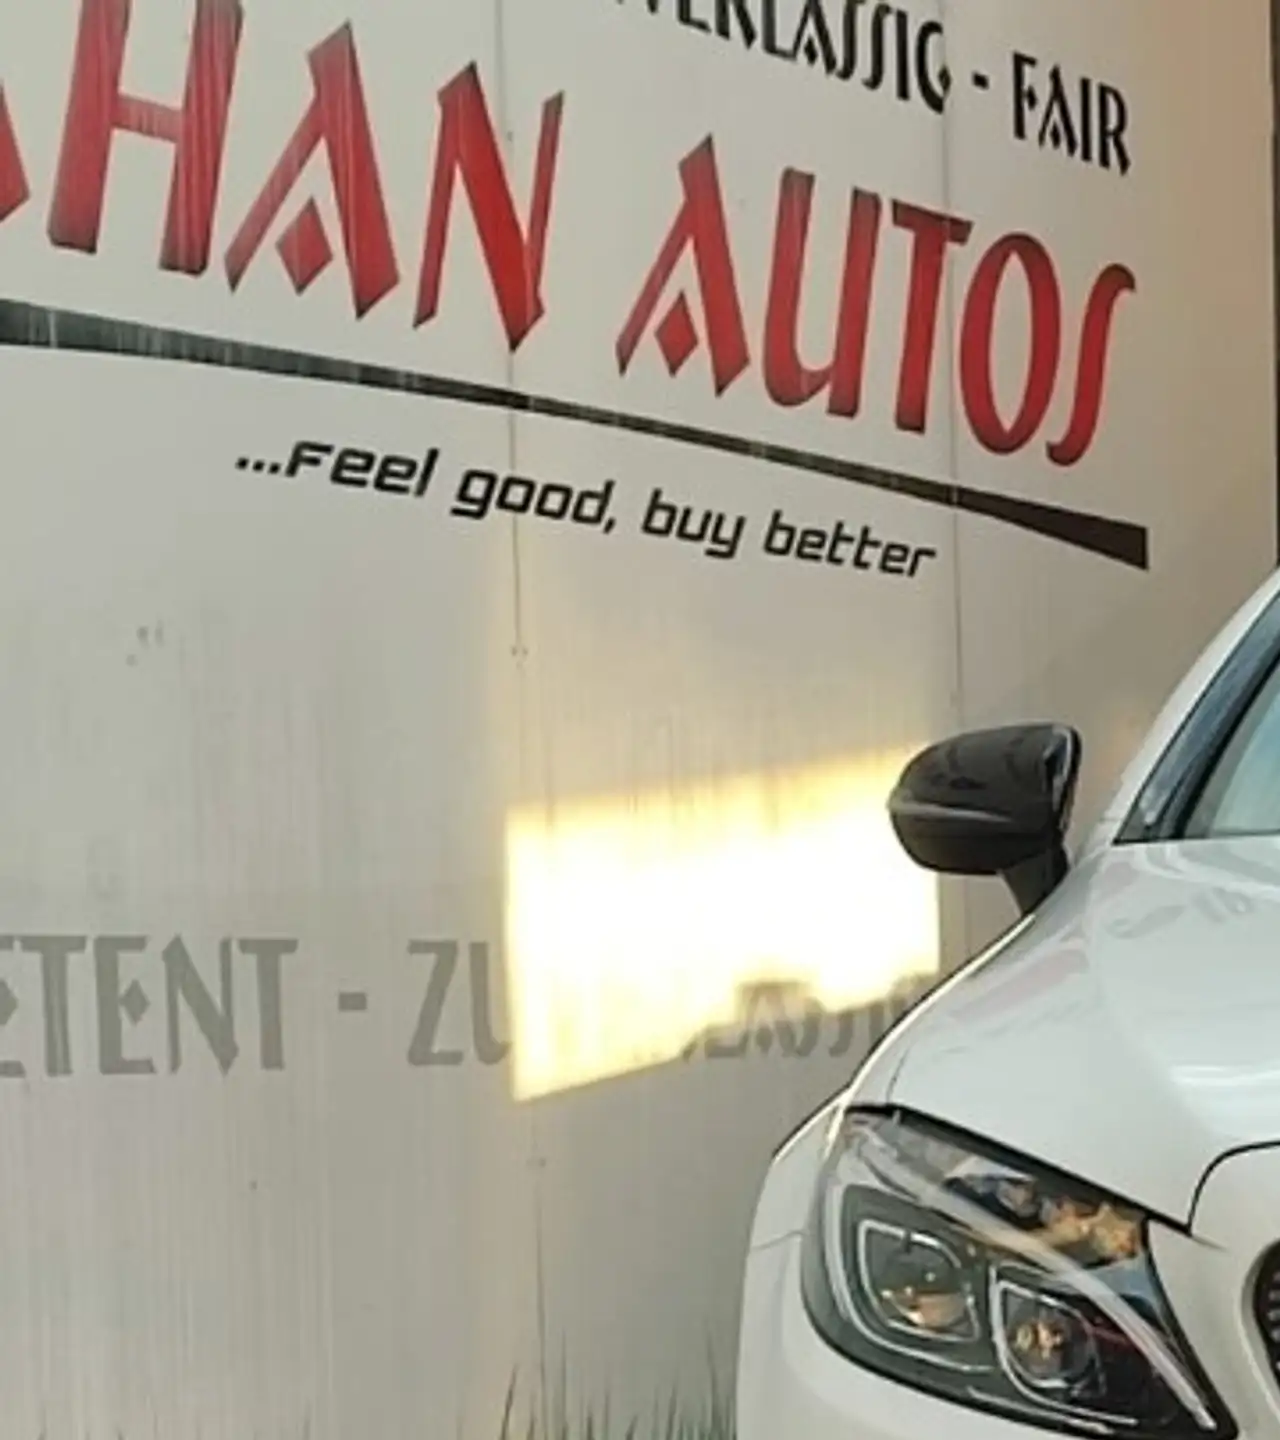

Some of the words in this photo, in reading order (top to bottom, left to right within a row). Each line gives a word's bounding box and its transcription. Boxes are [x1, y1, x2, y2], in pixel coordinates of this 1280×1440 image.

[1012, 51, 1131, 176] FAIR
[0, 0, 566, 353] HAN
[615, 134, 1137, 468] AUTOS
[450, 469, 617, 534] good,
[641, 488, 746, 560] buy
[763, 510, 937, 577] better
